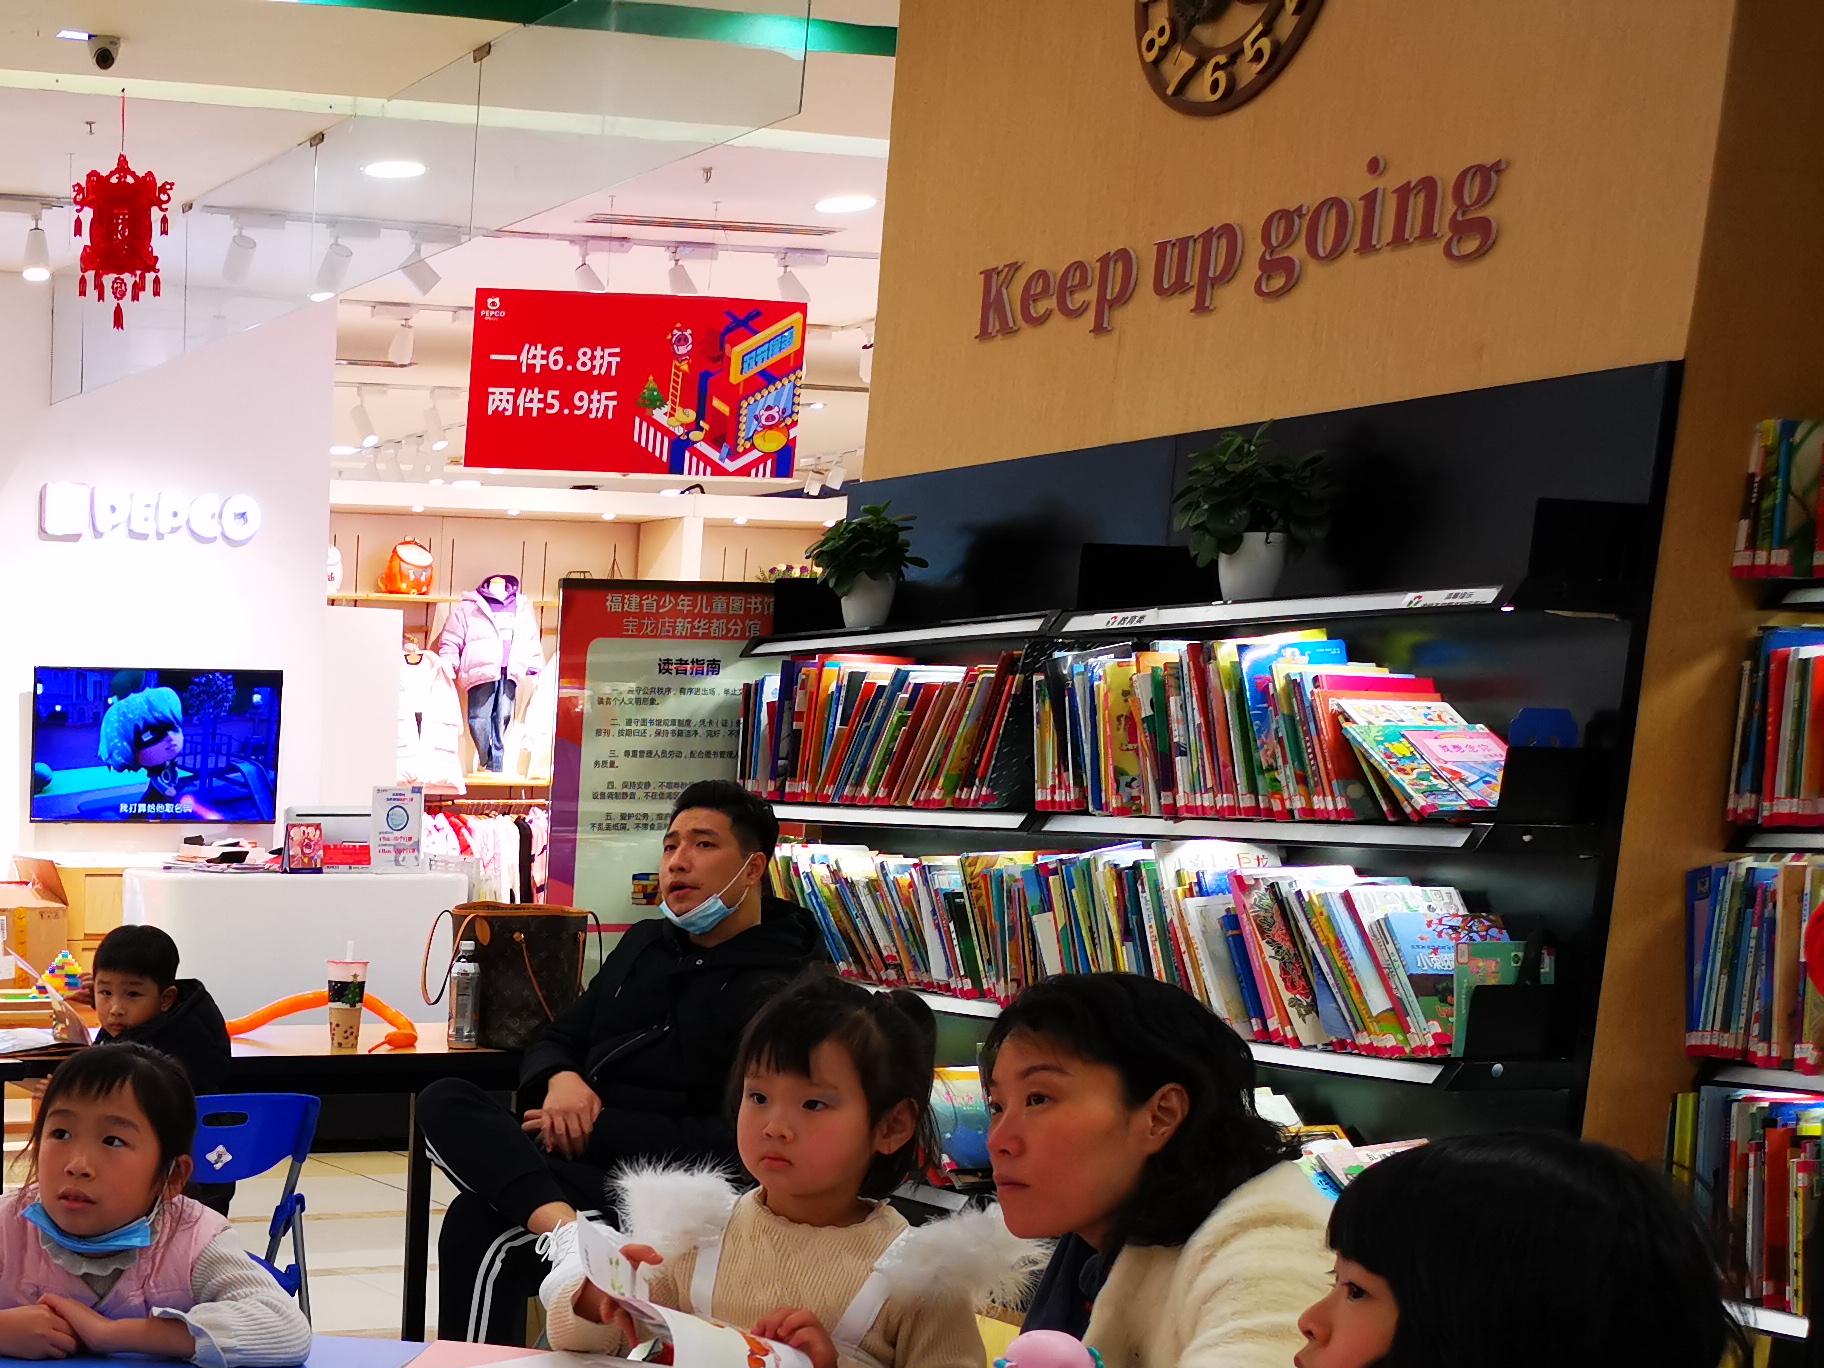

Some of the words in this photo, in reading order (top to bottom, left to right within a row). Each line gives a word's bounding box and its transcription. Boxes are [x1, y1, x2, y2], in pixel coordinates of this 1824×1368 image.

[1243, 21, 1272, 75] 5
[1204, 54, 1228, 102] 6
[974, 245, 1138, 341] Keep
[1152, 220, 1243, 314] up
[1253, 155, 1510, 300] going
[489, 343, 621, 376] 一件6.8折
[486, 387, 618, 420] 两件5.9折
[657, 657, 722, 677] 读者指南
